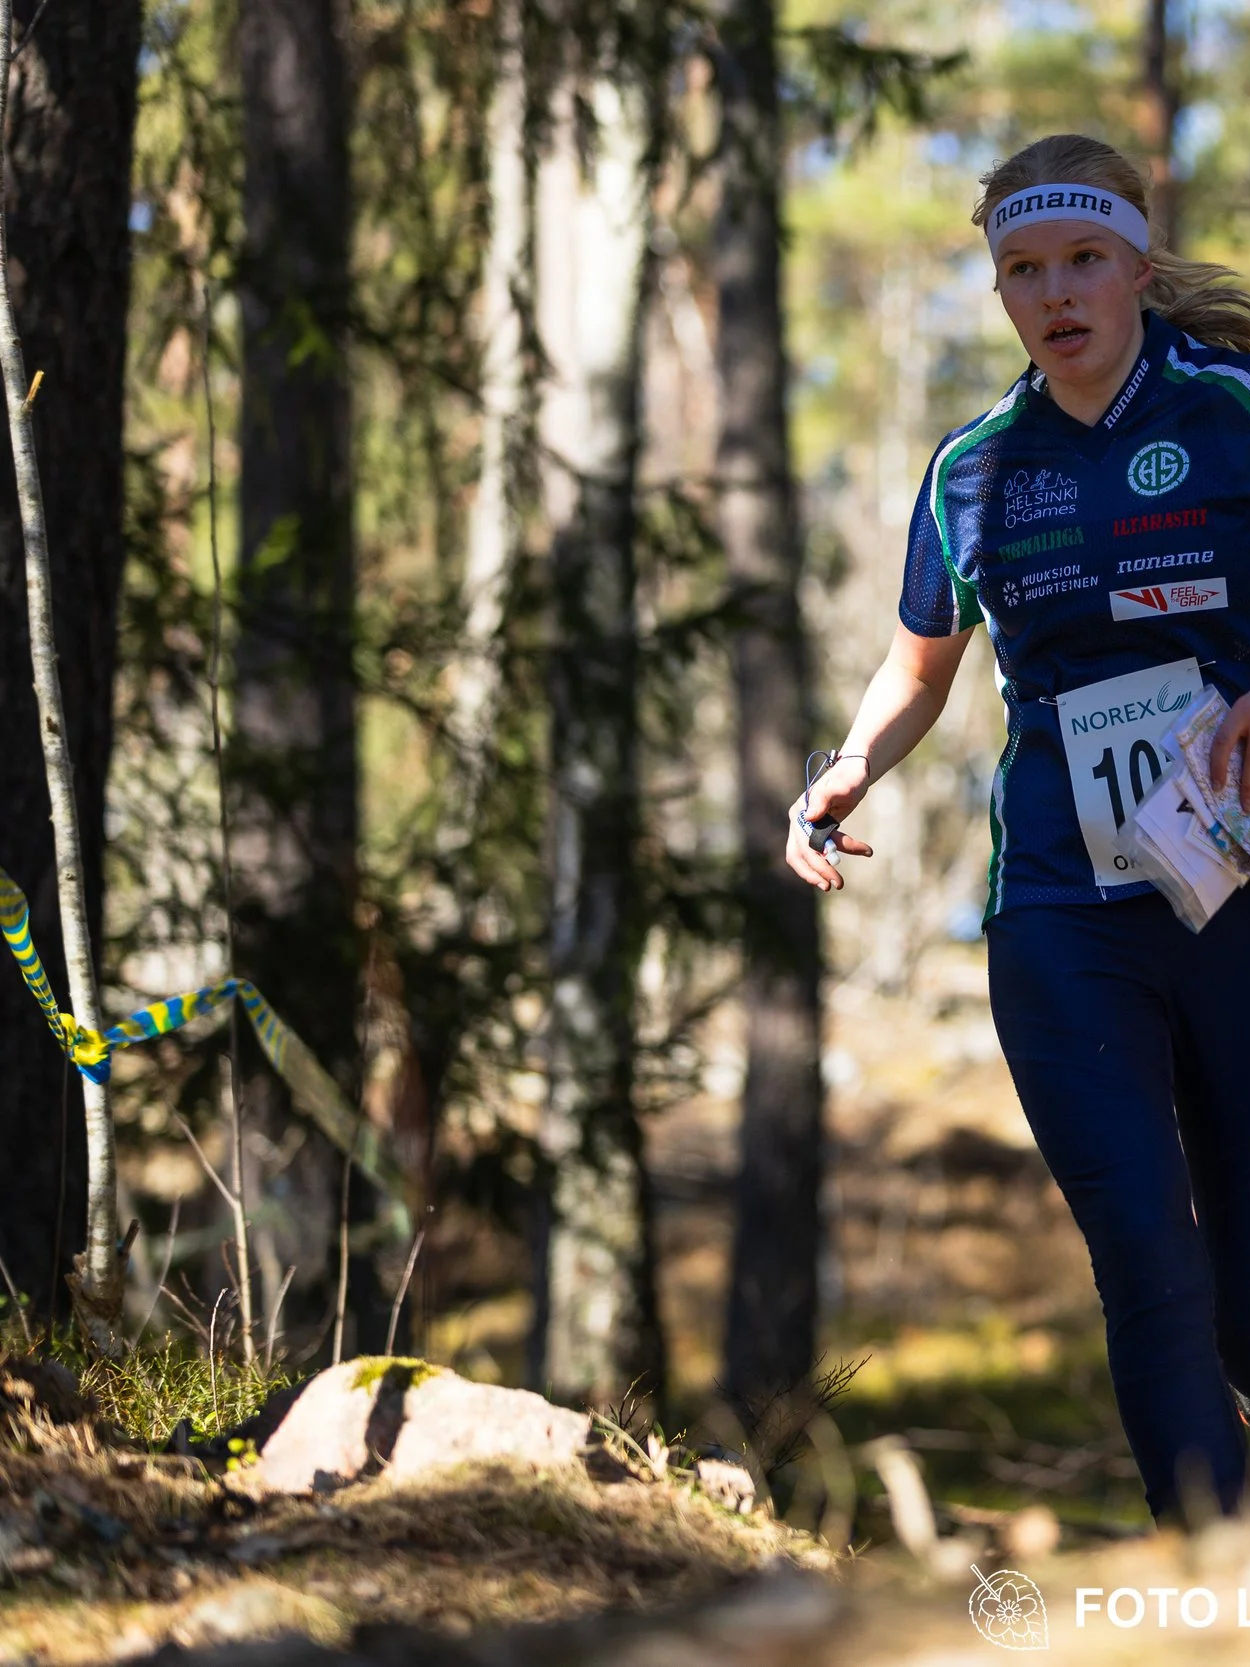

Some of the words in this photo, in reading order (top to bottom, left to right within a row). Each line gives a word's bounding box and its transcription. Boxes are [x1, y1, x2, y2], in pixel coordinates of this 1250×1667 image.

[995, 191, 1113, 229] noname
[1104, 358, 1149, 430] noname
[1005, 486, 1078, 514] HELSINKI
[1005, 503, 1077, 529] O-Games
[1021, 564, 1081, 587] NUUKSION
[1116, 550, 1214, 575] noname
[1025, 576, 1099, 601] HUURTEINEN
[1170, 586, 1199, 598] FEEL
[1180, 595, 1209, 608] GRIP
[1071, 698, 1156, 735] NOREX
[1092, 739, 1174, 836] 10
